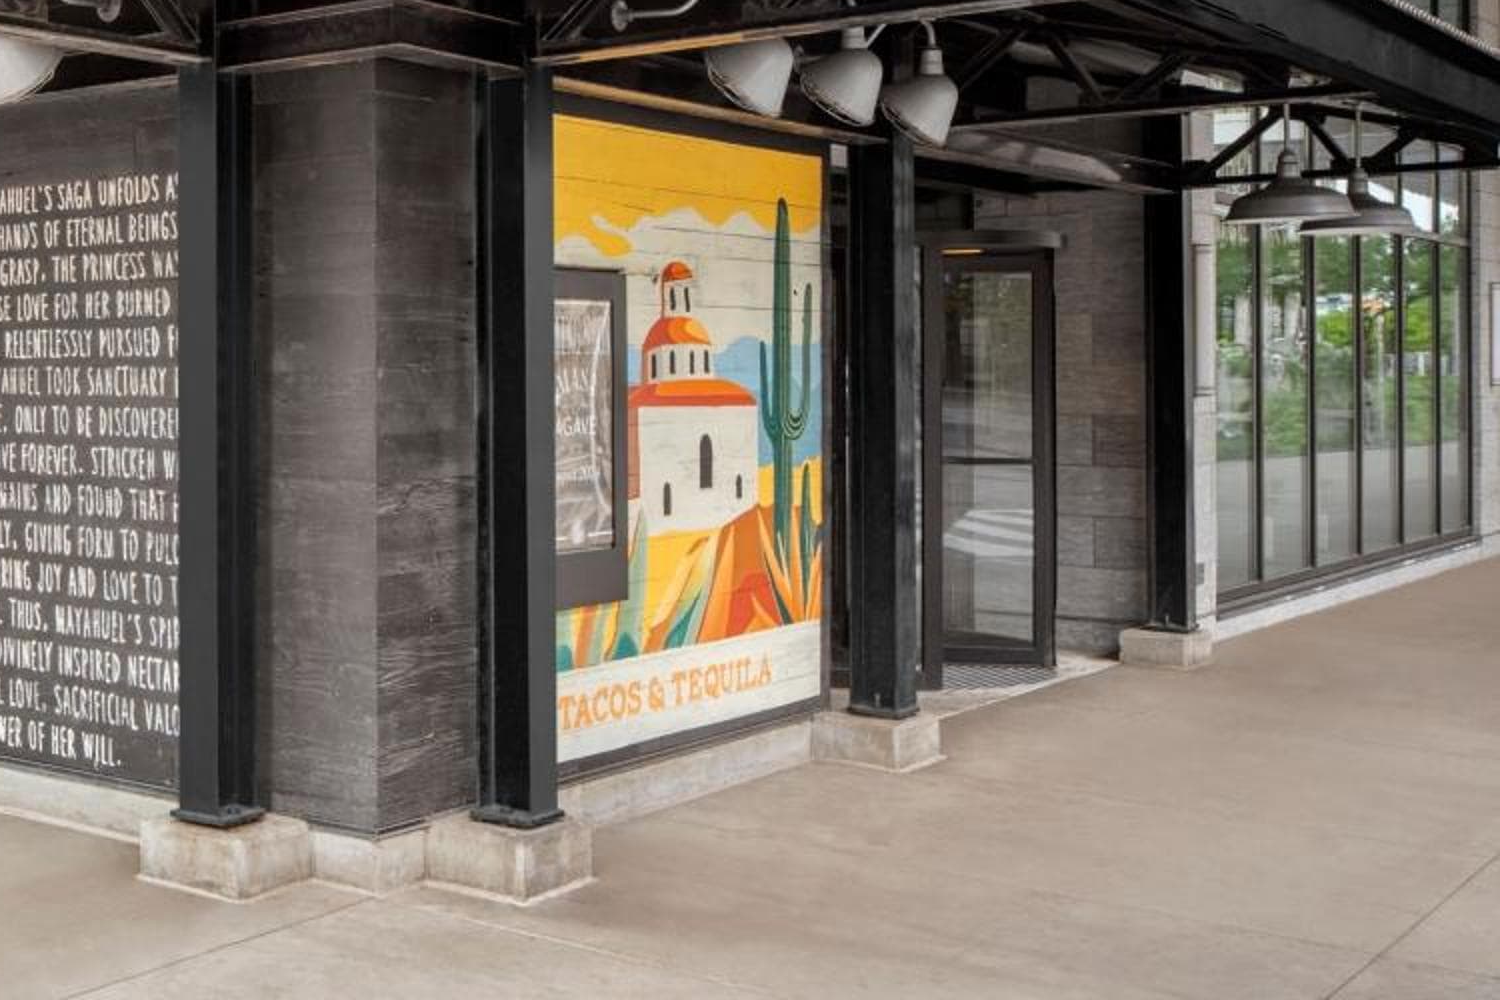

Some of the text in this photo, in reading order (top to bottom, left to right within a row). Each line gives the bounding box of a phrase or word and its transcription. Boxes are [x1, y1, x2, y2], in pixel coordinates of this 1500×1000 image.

[57, 181, 93, 211] SAGA
[98, 174, 160, 207] UNFOLDS
[44, 220, 60, 248] OF
[66, 215, 124, 247] ETERNAL
[128, 212, 178, 243] BEINGS
[52, 255, 77, 283] THE
[83, 252, 146, 281] PRINCESS
[17, 294, 49, 322] LOVE
[54, 292, 79, 320] FOR
[85, 290, 110, 319] HER
[115, 287, 171, 318] BURNED
[5, 328, 93, 358] RELENTLESSLY
[99, 326, 161, 358] PURSUED
[46, 365, 81, 396] TOOK
[87, 365, 167, 398] SANCTUARY
[15, 404, 47, 435] ONLY
[52, 405, 70, 436] TO
[76, 406, 93, 437] BE
[100, 406, 179, 439] DISCOVERE
[91, 447, 155, 480] STRICKEN
[44, 482, 71, 515] AND
[77, 484, 123, 520] FOUND
[129, 488, 167, 523] THAT
[24, 520, 71, 556] GIVING
[77, 524, 115, 561] FORM
[119, 527, 139, 563] TO
[37, 561, 63, 595] JOY
[68, 564, 97, 600] AND
[103, 568, 138, 604] LOVE
[142, 572, 163, 606] TO
[58, 642, 121, 684] INSPIRED
[53, 682, 138, 732] SACRIFICIAL
[558, 650, 773, 729] TACOS & TEQUILA
[28, 719, 45, 753] OF
[51, 723, 77, 762] HER
[81, 729, 122, 768] WILL.
